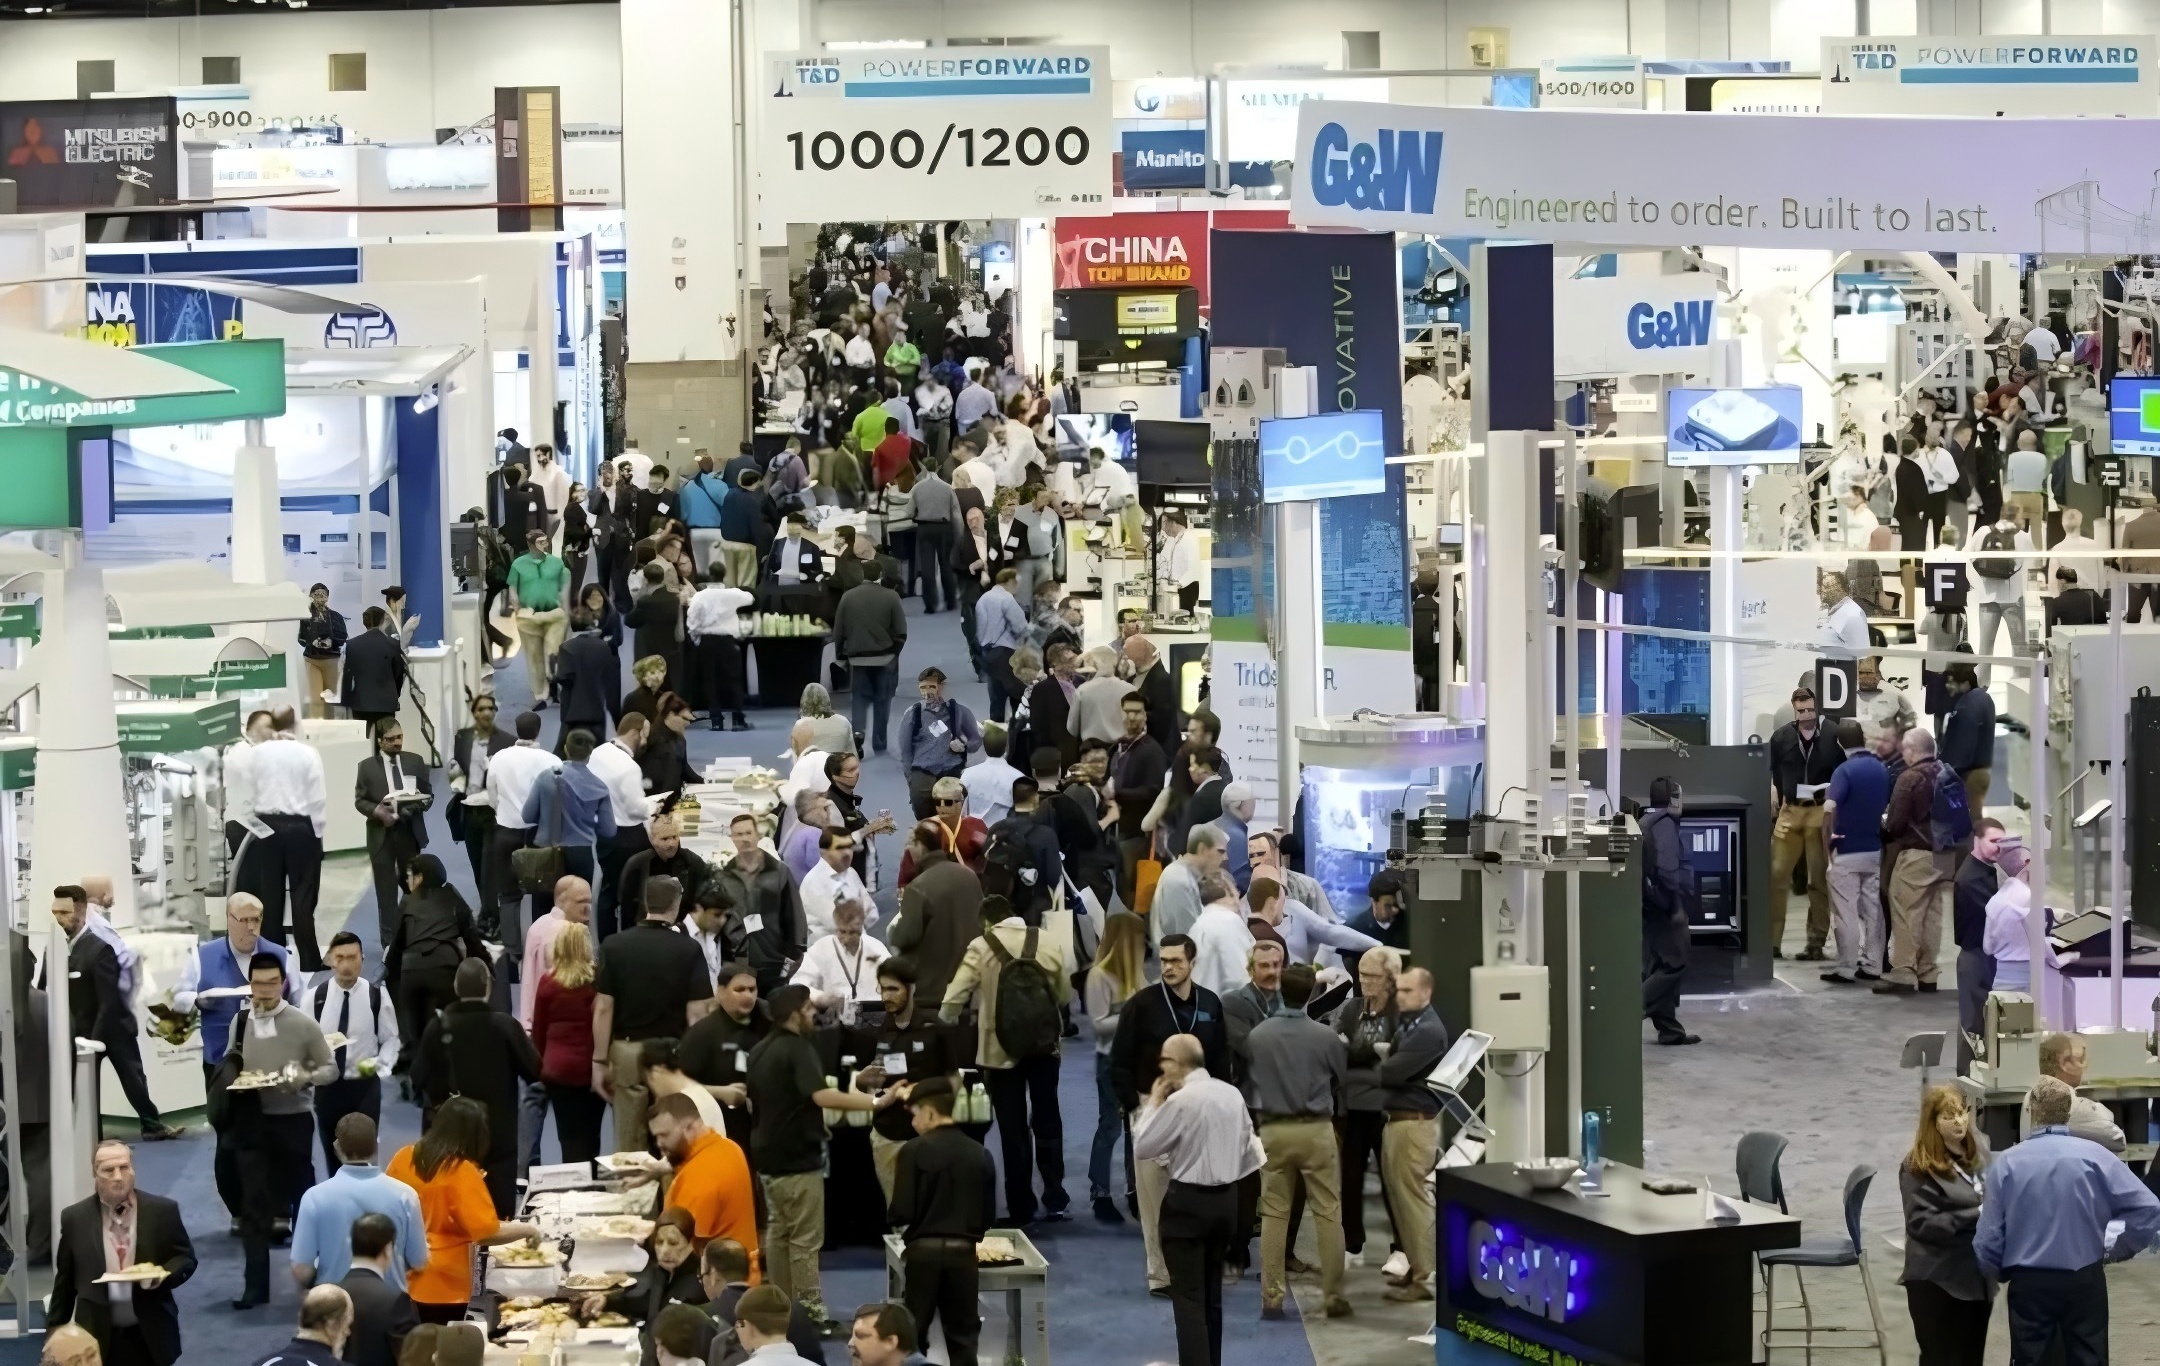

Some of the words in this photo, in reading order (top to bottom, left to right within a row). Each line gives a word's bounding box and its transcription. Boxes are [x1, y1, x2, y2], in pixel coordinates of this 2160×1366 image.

[864, 57, 1091, 78] POWERFORWARD
[786, 122, 1090, 175] 1000/1200
[1311, 122, 1444, 215] G&W
[1464, 188, 1618, 229] Engineered
[1627, 195, 1660, 223] to
[1670, 194, 1768, 229] order.
[1782, 197, 1862, 231] Built
[1872, 203, 1911, 232] to
[1924, 197, 1998, 233] last.
[1084, 235, 1188, 264] CHINA
[1126, 264, 1192, 282] BRAND
[1627, 300, 1714, 349] G&W
[1933, 568, 1957, 602] F
[1822, 666, 1849, 709] D
